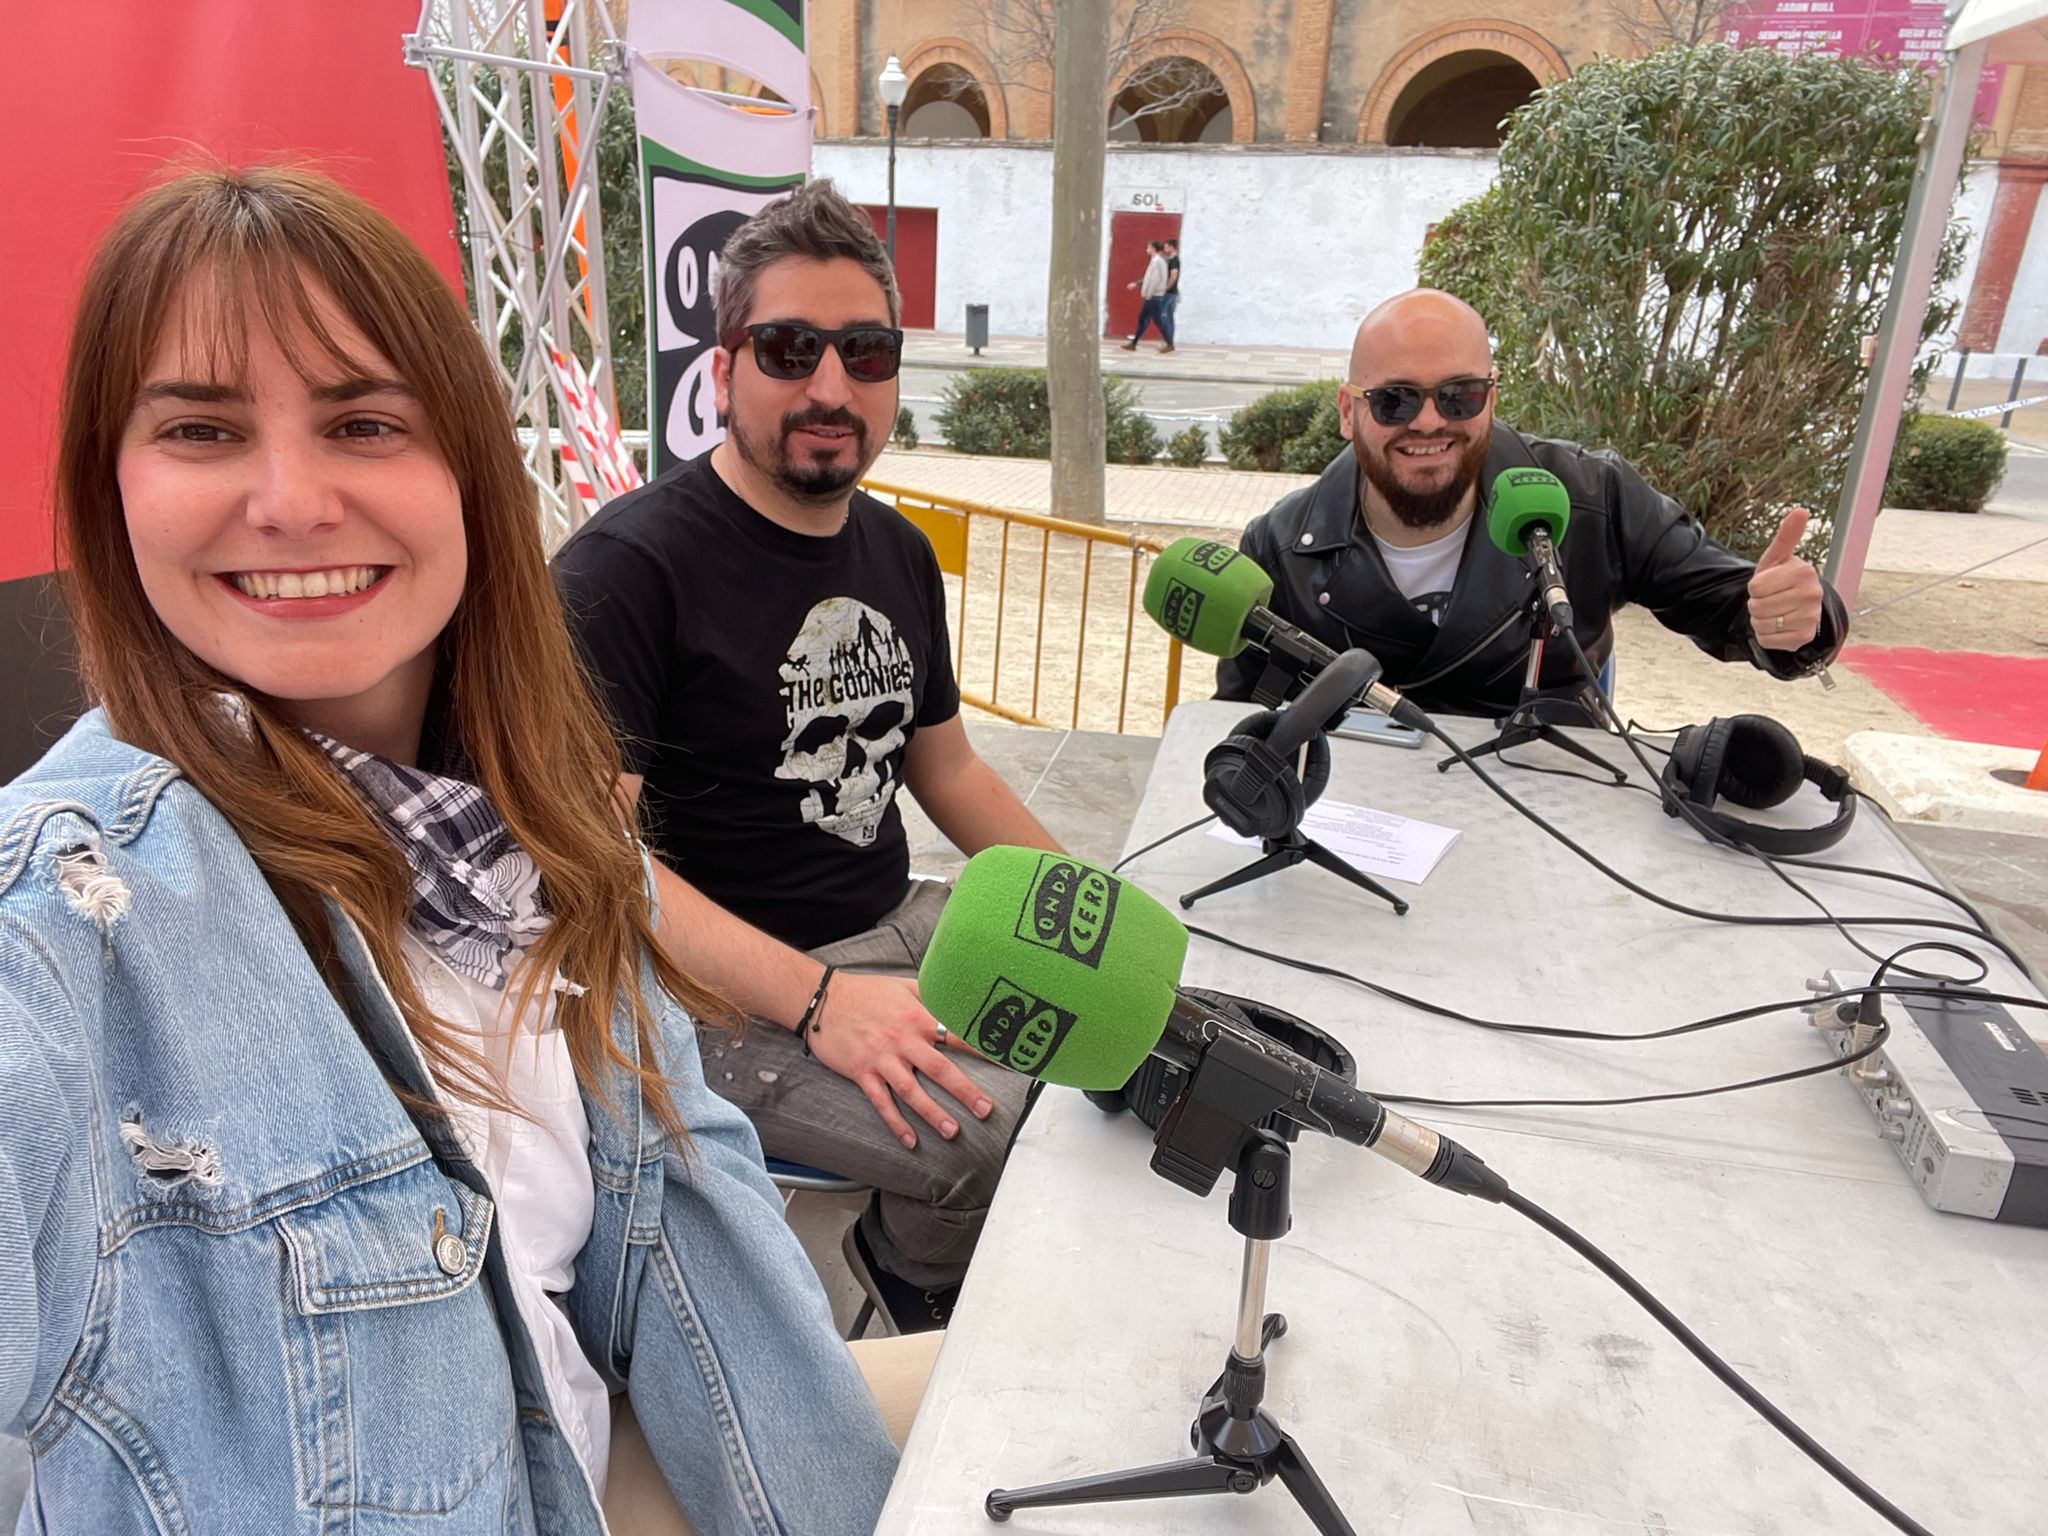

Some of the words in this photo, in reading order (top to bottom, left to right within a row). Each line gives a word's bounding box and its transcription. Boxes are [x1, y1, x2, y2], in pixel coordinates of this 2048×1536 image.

[1132, 194, 1162, 206] SOL
[1038, 868, 1073, 934] ONDA
[1072, 876, 1108, 942] CERO
[983, 1004, 1021, 1054] ONDA
[1012, 1018, 1053, 1068] CERO
